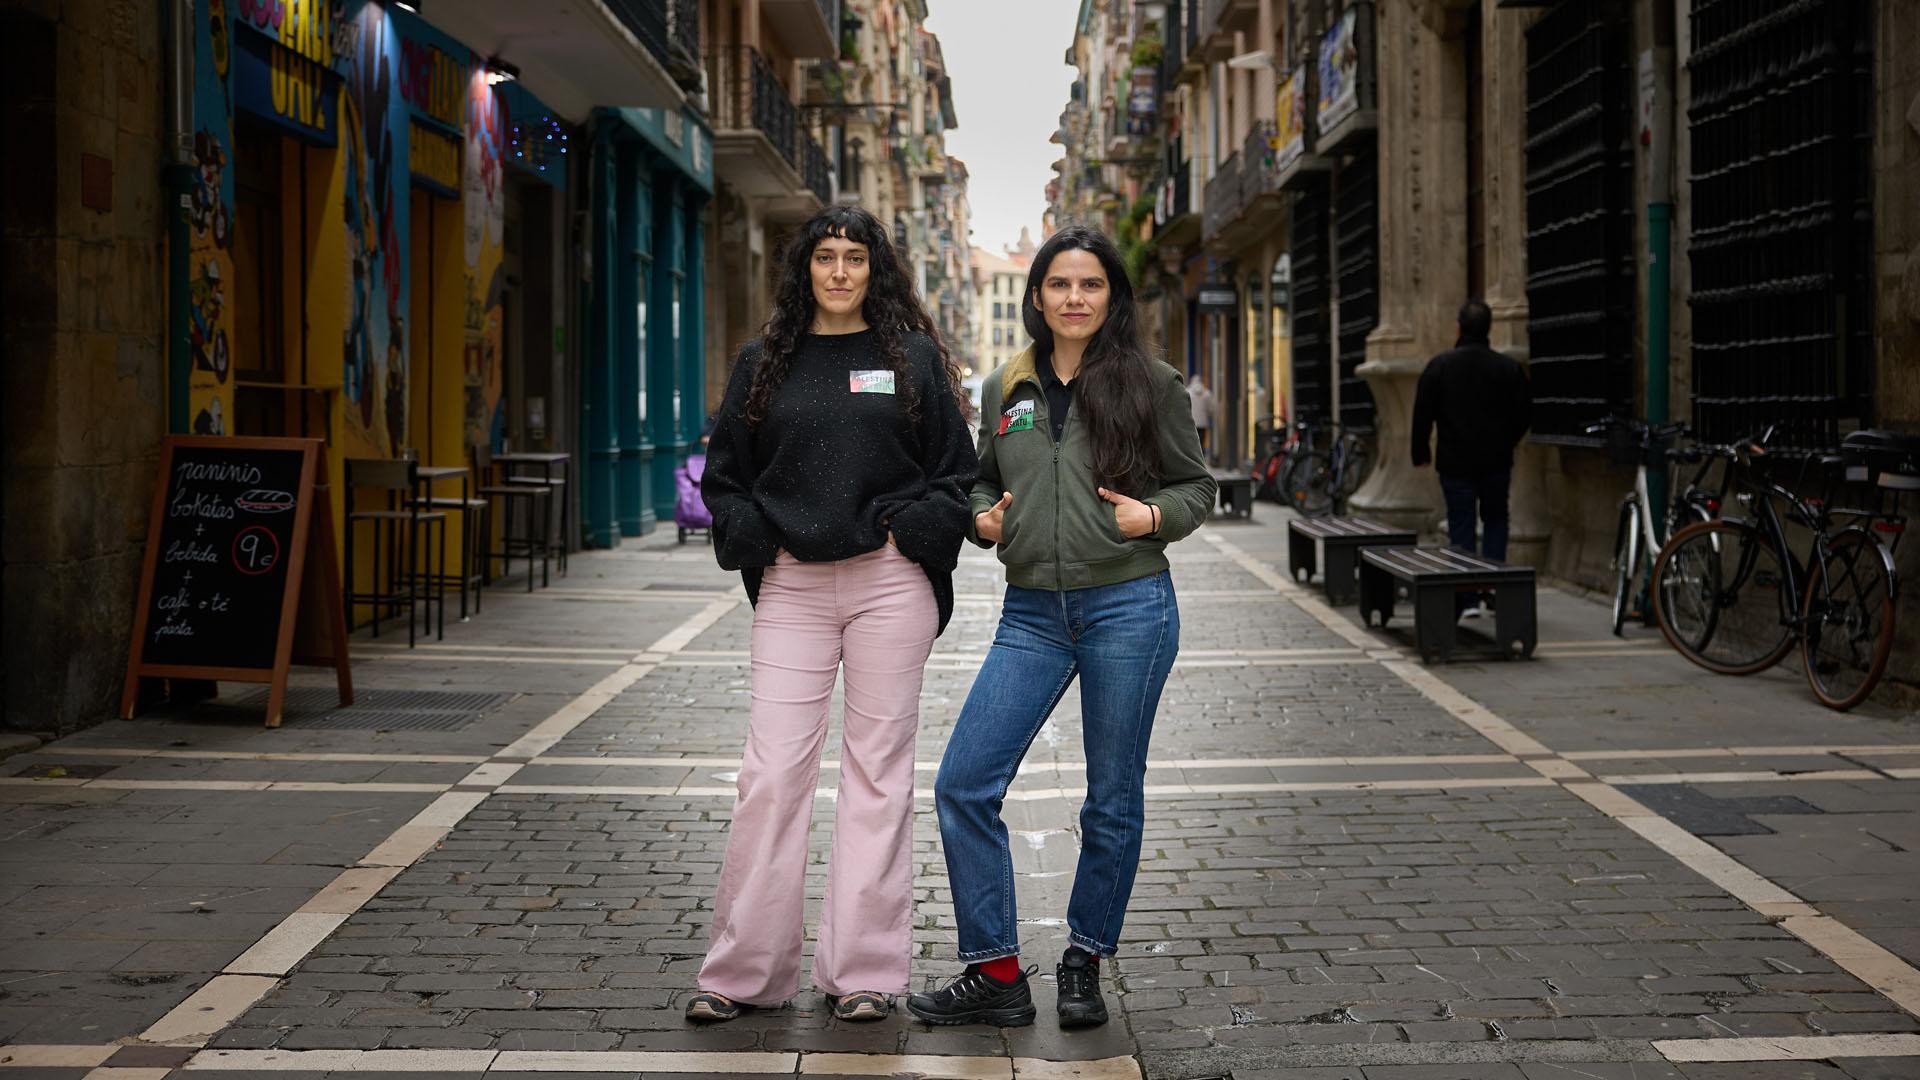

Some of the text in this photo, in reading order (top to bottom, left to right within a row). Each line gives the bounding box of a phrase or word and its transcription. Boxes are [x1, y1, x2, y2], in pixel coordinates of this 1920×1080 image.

[1002, 407, 1032, 418] ALESTINA
[177, 461, 261, 488] paninis
[166, 540, 217, 562] bebida
